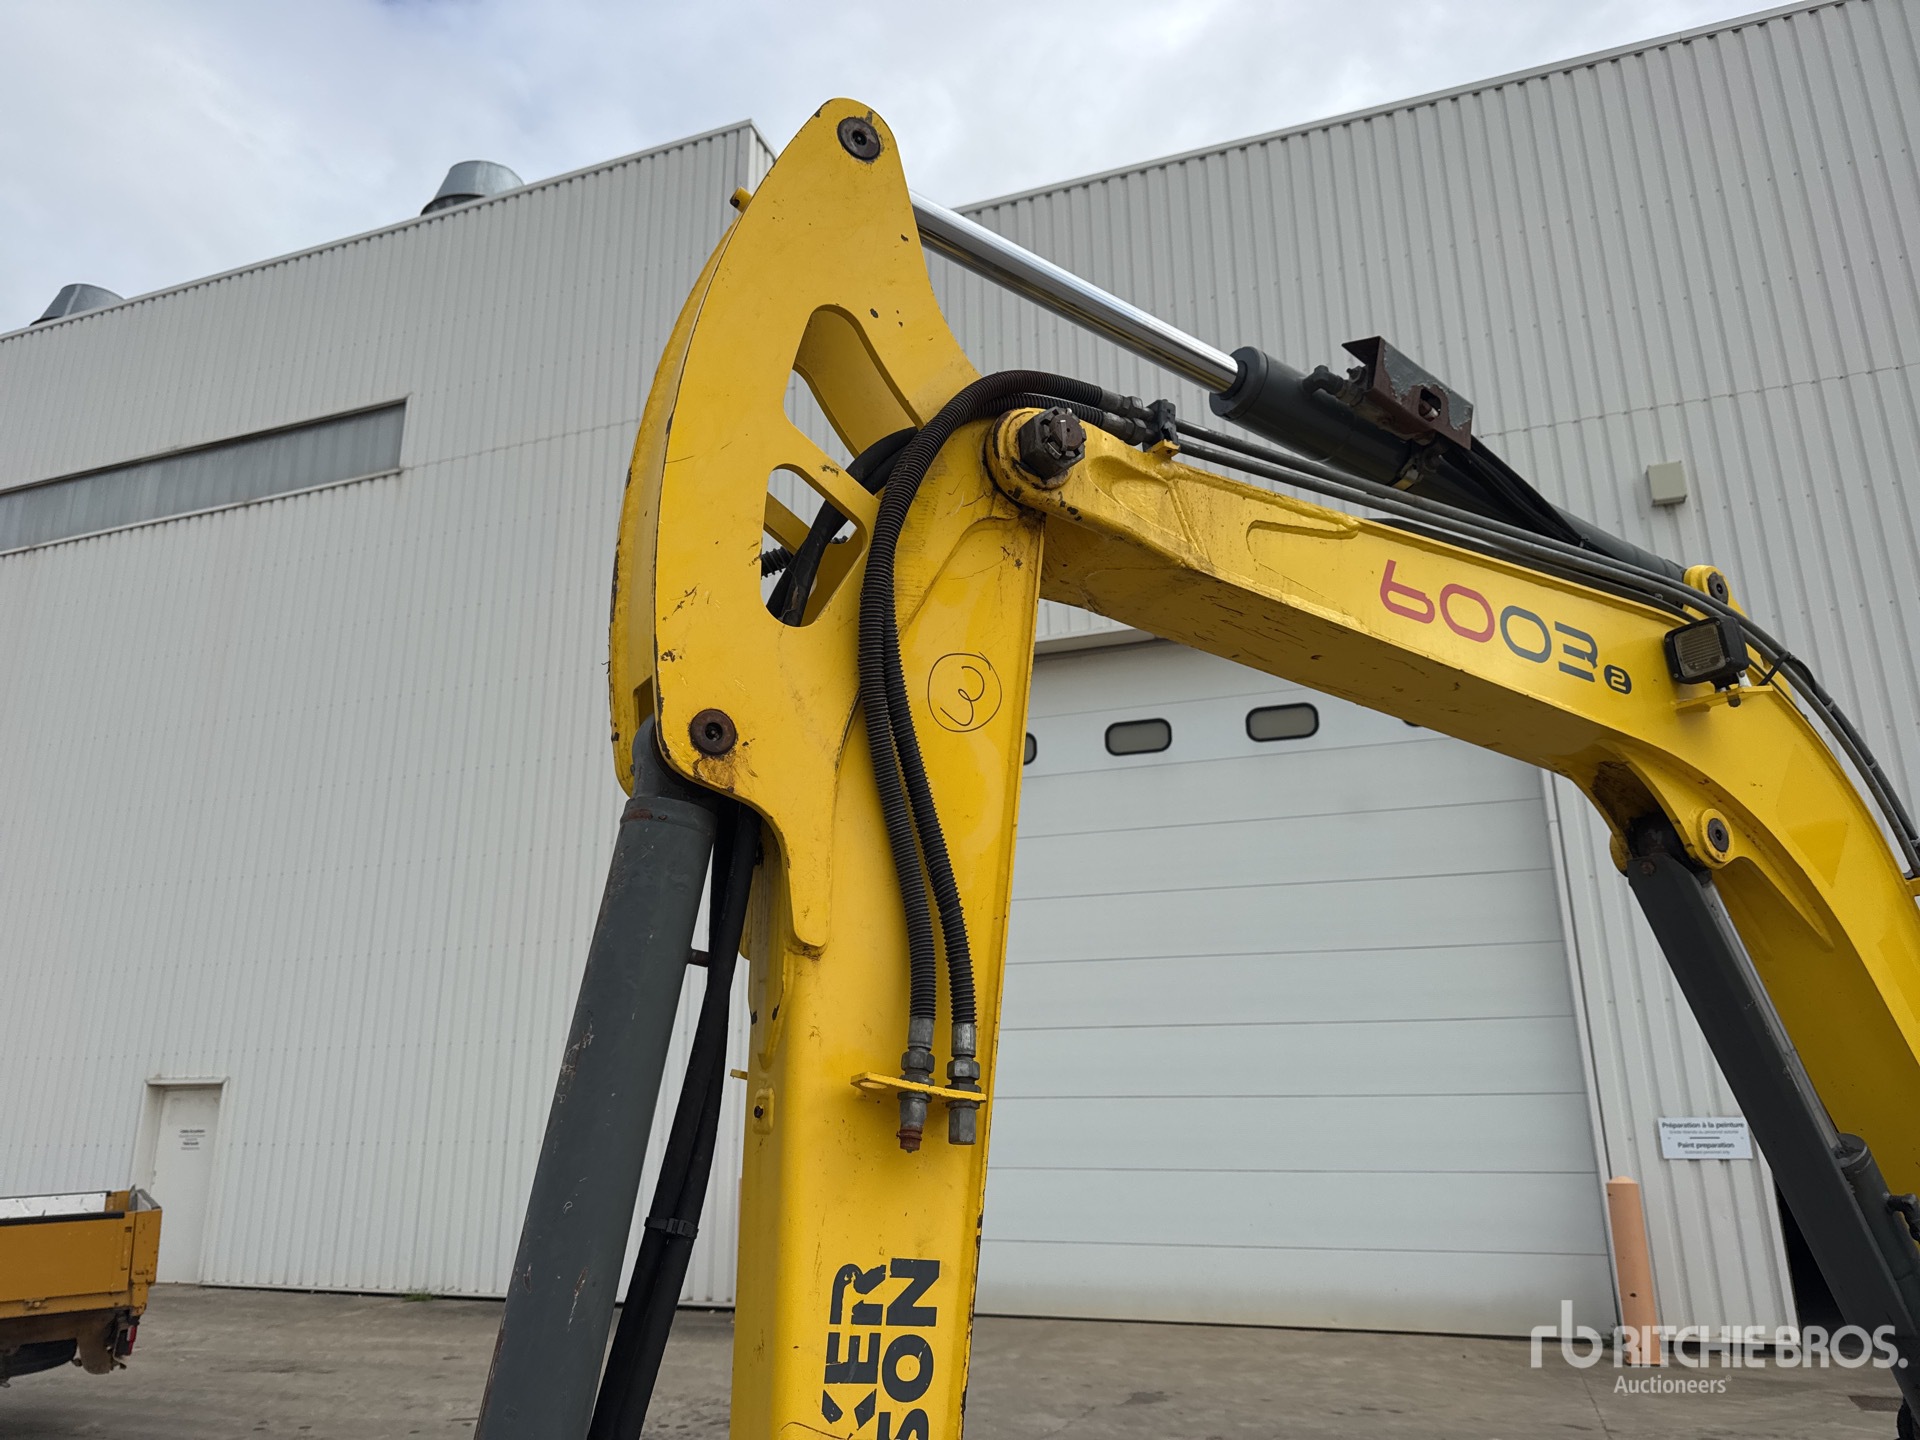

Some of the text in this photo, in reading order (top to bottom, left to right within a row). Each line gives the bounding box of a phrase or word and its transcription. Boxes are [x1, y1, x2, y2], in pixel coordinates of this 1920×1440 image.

[1380, 560, 1630, 693] 6003 2
[1696, 1142, 1735, 1150] preparation
